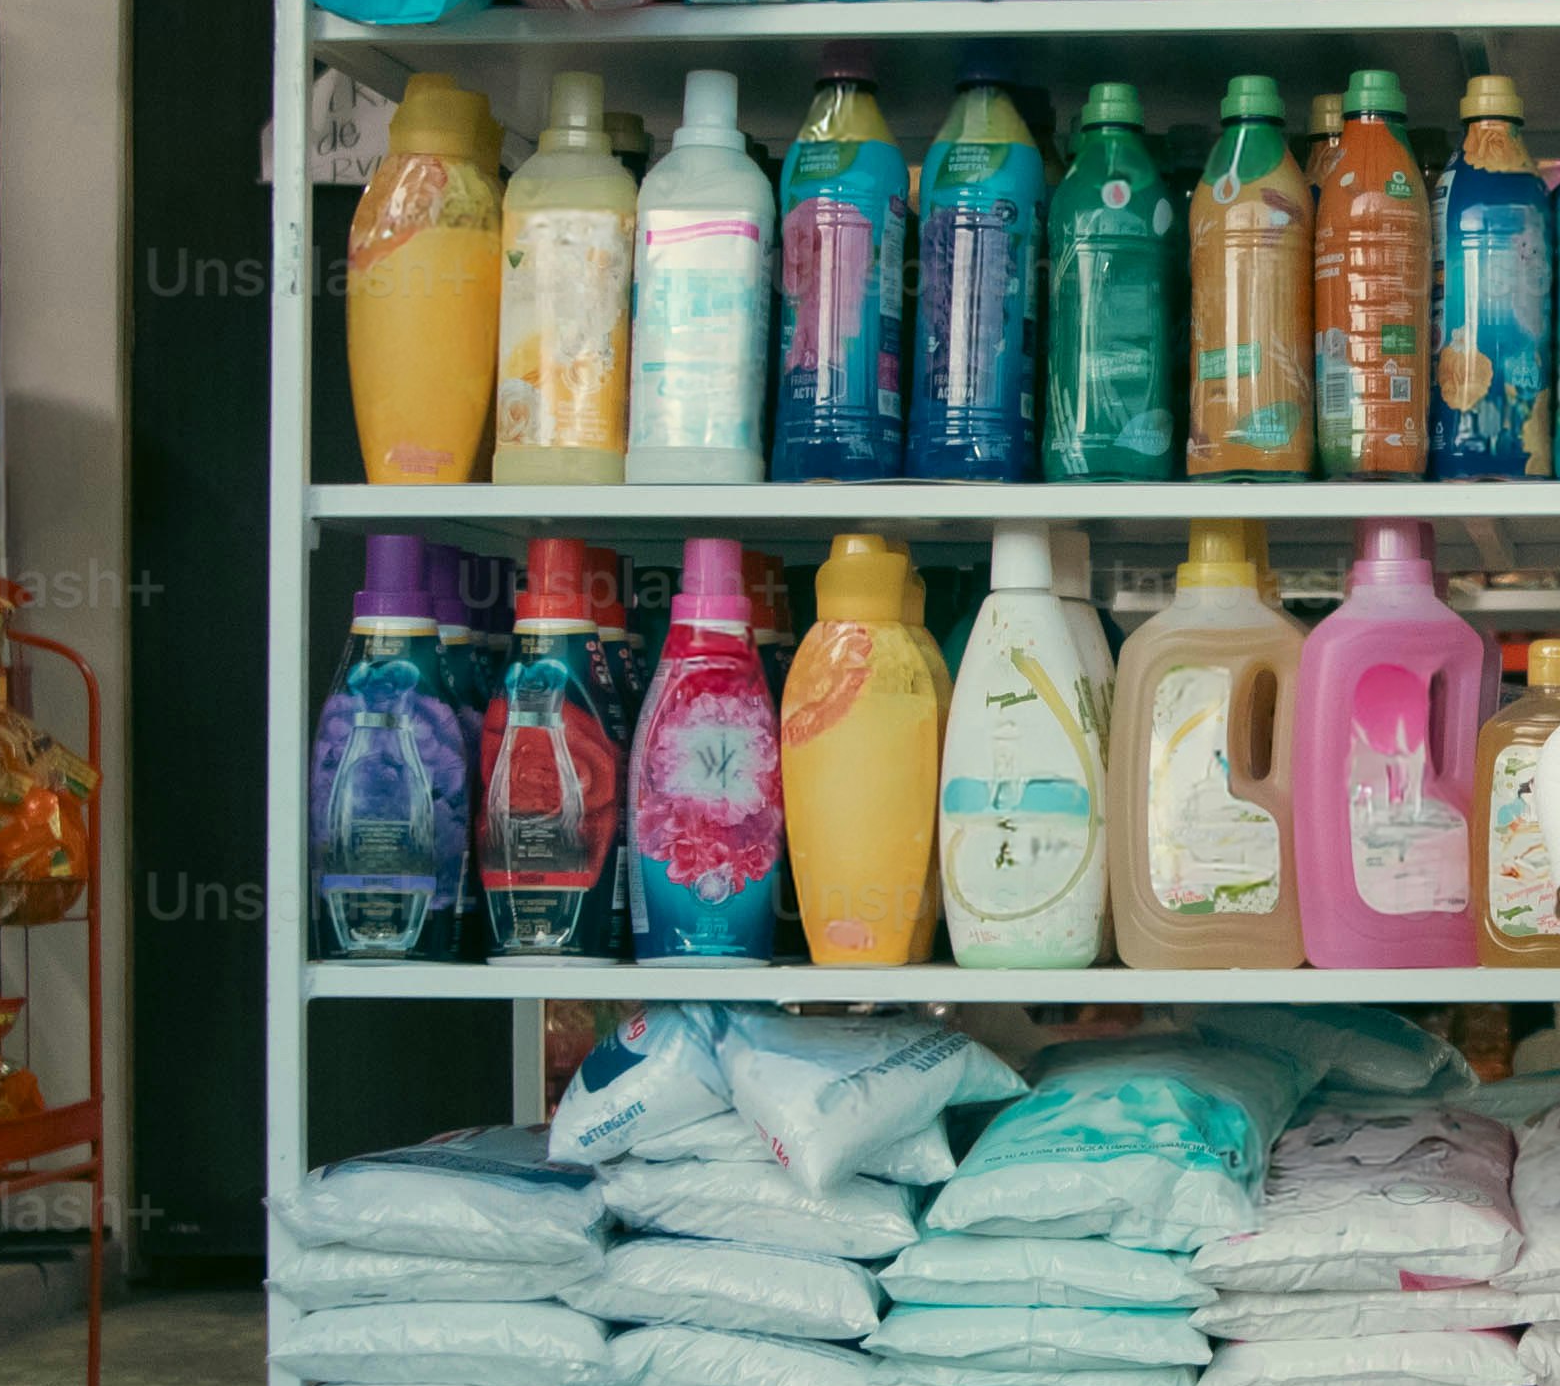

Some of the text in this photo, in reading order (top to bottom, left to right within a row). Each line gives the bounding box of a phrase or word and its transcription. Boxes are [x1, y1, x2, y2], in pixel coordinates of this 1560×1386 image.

[317, 118, 360, 156] de
[948, 162, 988, 172] VEGETAL
[936, 386, 974, 401] ACTIVA
[909, 1034, 969, 1074] ERGENTE
[578, 1100, 647, 1148] DETERGENTE
[1056, 1144, 1104, 1154] BIOLÓGICA
